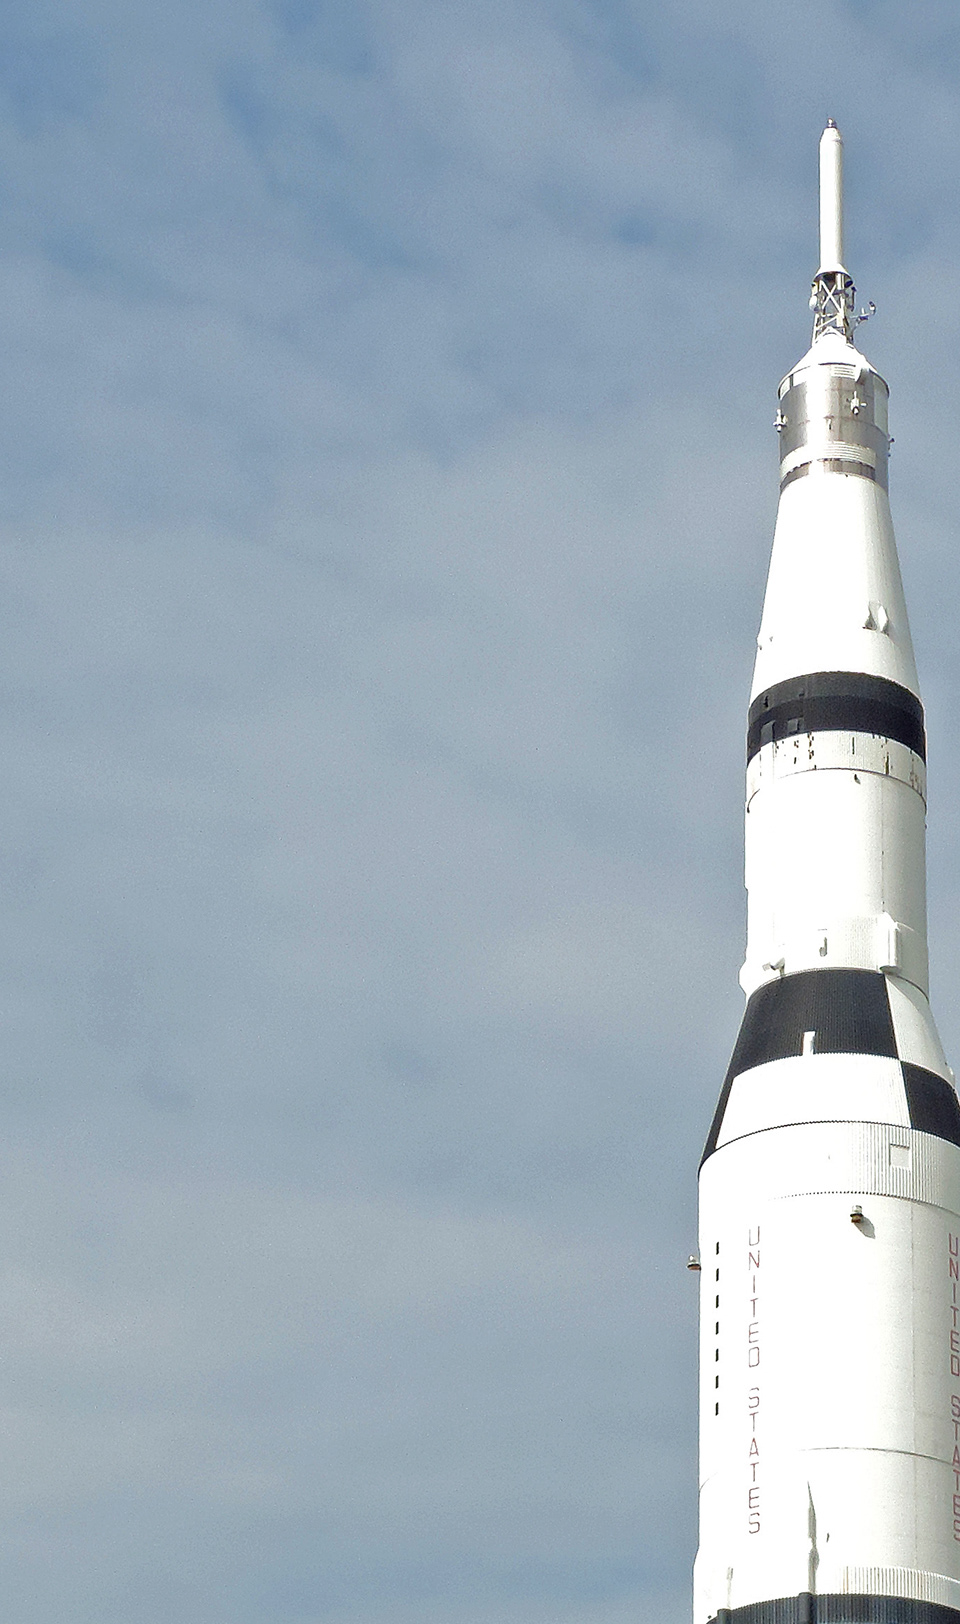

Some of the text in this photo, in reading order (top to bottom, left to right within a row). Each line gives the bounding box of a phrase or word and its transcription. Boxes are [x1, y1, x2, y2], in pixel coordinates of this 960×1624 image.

[748, 1225, 760, 1534] UNITED STATES
[949, 1232, 960, 1377] UNITED
